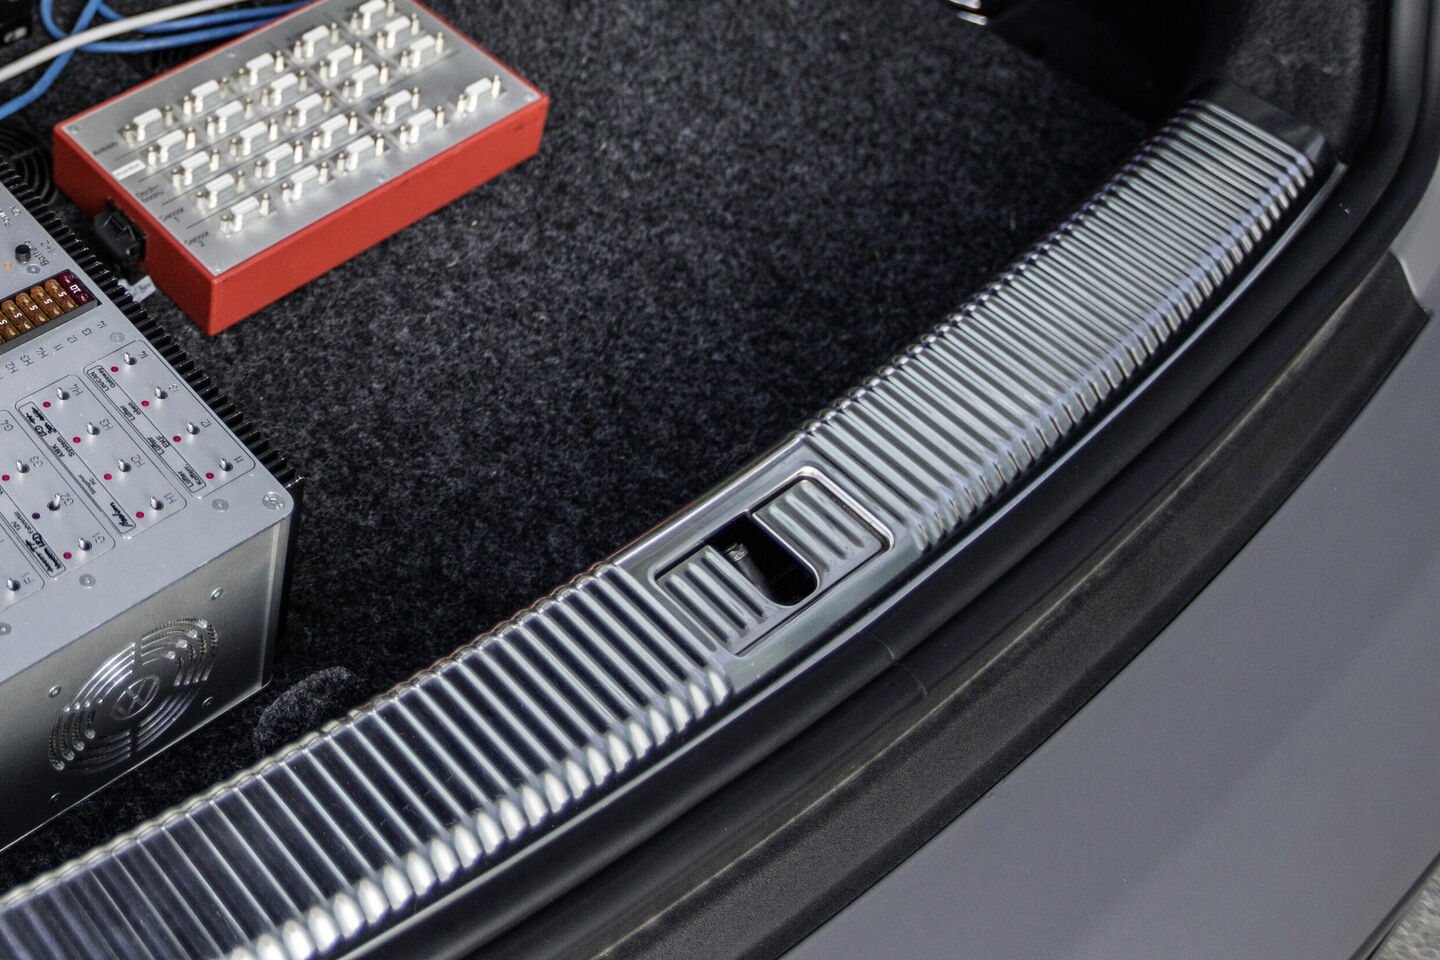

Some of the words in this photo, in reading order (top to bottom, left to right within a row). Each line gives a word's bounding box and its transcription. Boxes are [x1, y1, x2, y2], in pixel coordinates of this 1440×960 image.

[117, 404, 136, 421] Lüfter
[126, 401, 141, 416] oben
[98, 417, 114, 431] H3
[54, 435, 76, 457] System
[144, 435, 165, 455] Lüfter
[155, 434, 170, 448] EKF
[50, 443, 65, 458] AMK
[129, 453, 146, 467] H2
[175, 469, 195, 488] Lüfter
